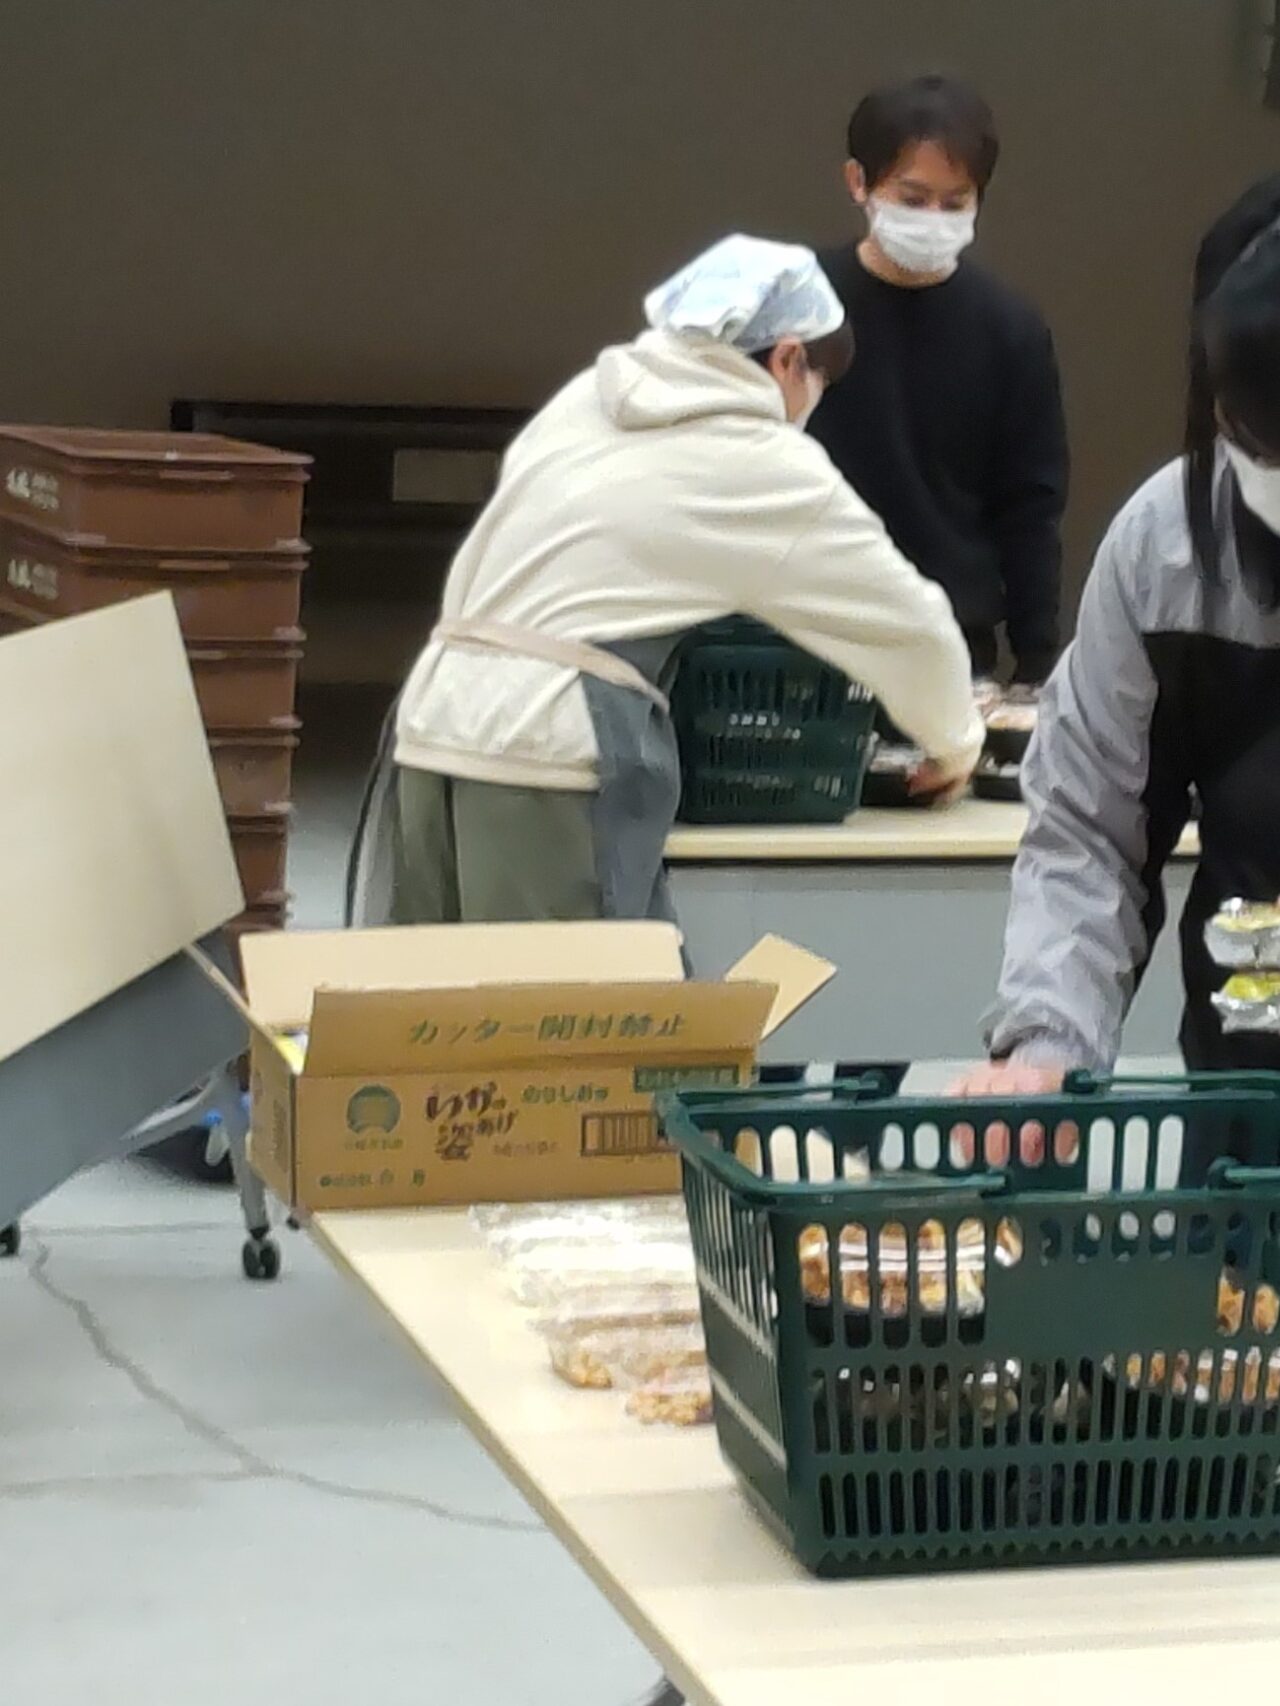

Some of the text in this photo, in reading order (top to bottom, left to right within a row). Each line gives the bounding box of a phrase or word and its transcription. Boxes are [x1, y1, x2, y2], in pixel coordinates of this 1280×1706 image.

[409, 1013, 684, 1044] カッター開封禁止
